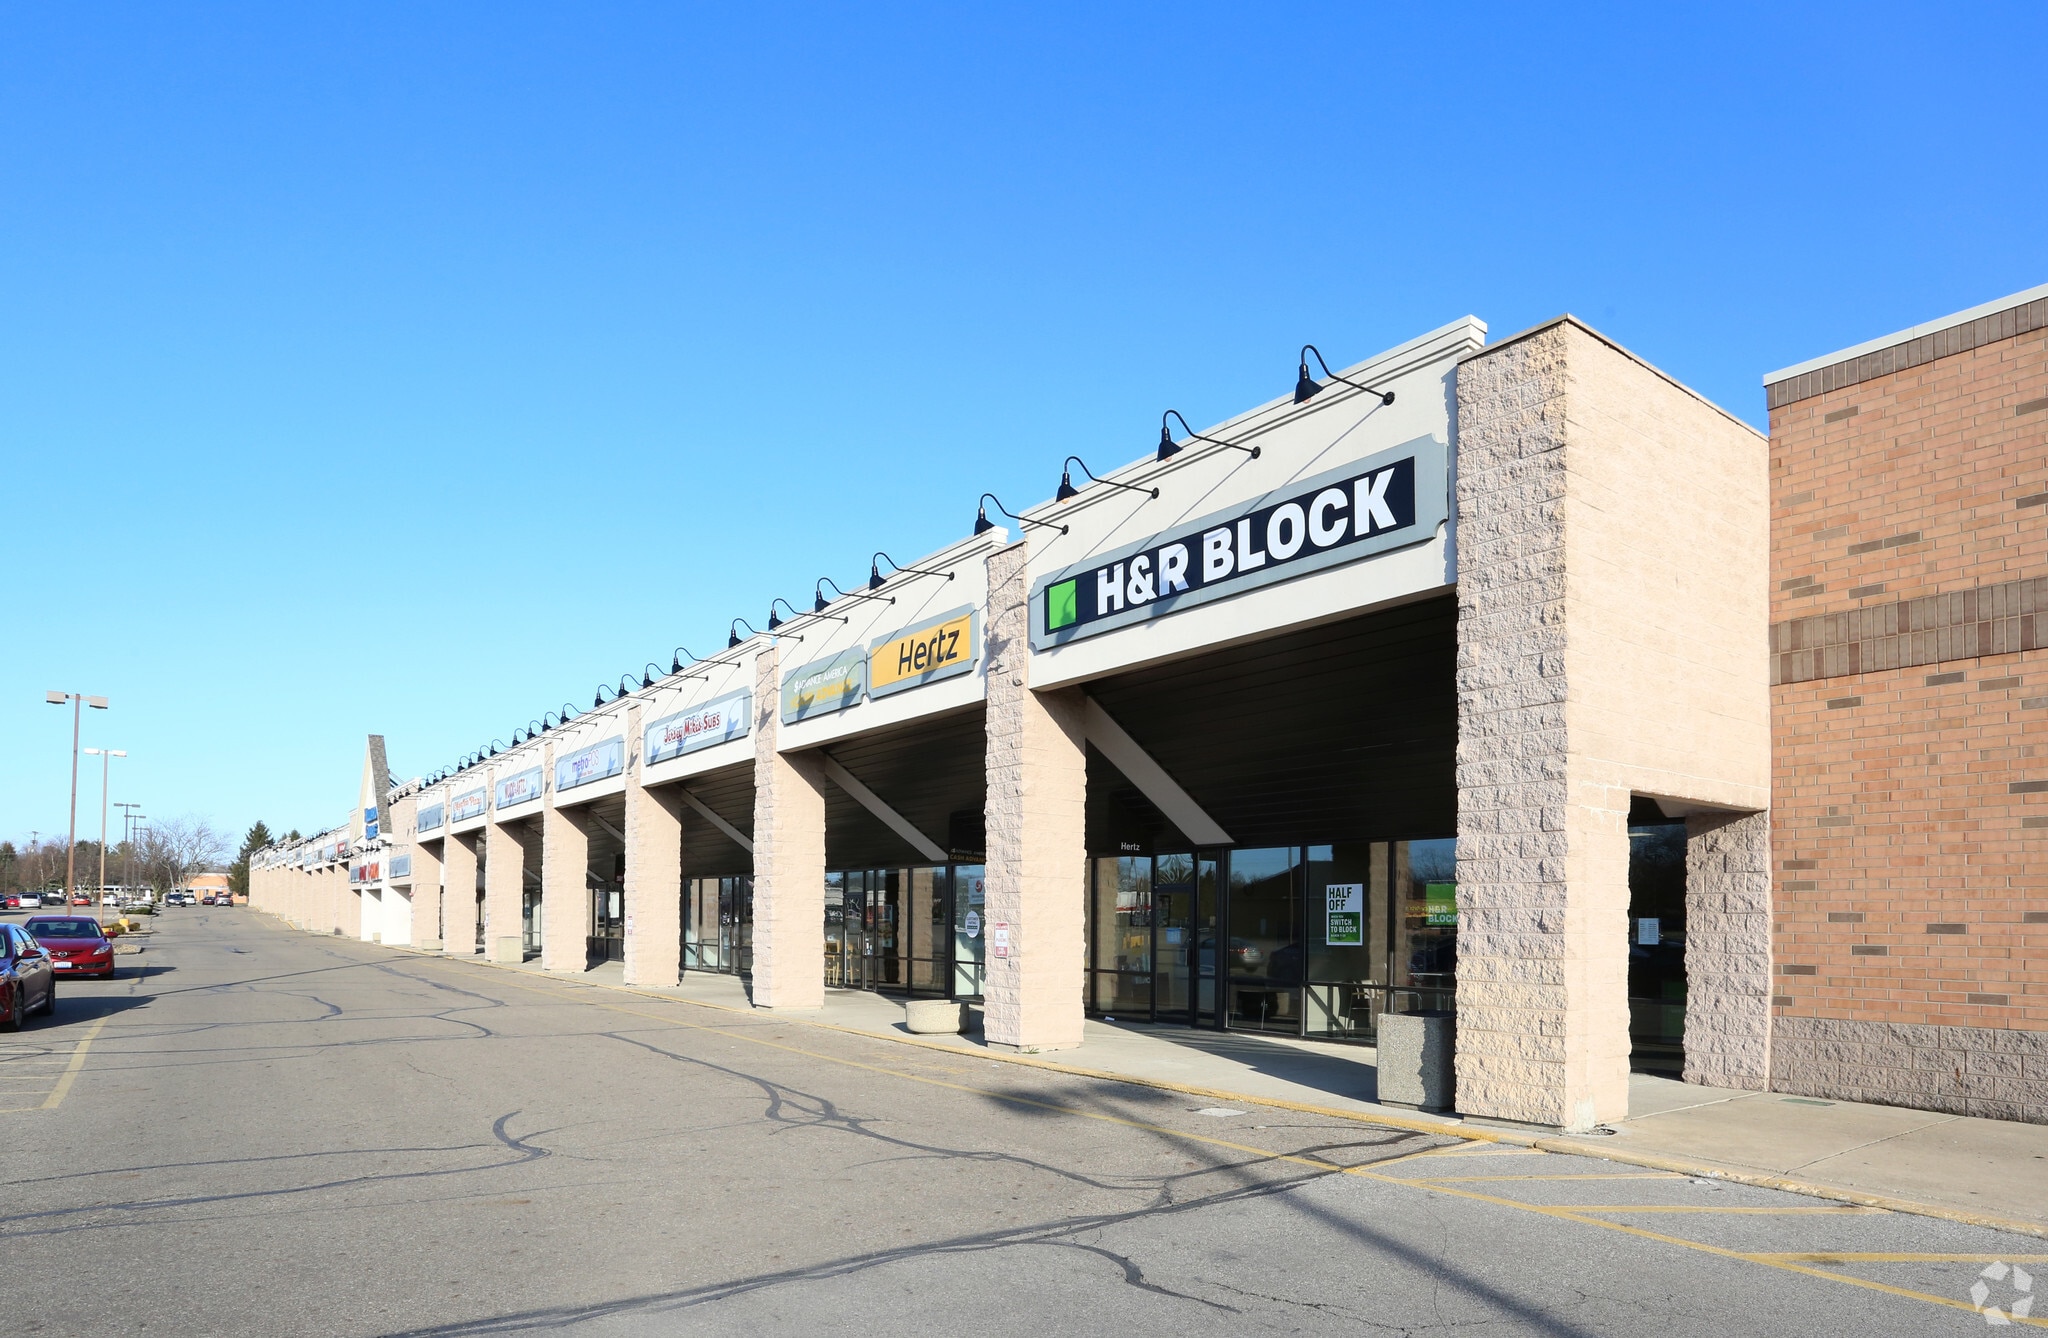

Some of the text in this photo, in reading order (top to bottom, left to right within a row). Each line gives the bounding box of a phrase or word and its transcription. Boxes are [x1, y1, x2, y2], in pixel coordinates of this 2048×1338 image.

[1097, 467, 1398, 616] H&R BLOCK
[898, 629, 960, 676] Hertz
[1120, 842, 1140, 851] Hertz
[1328, 887, 1352, 899] HALF
[1328, 900, 1346, 911] OFF
[1428, 905, 1447, 914] H&R
